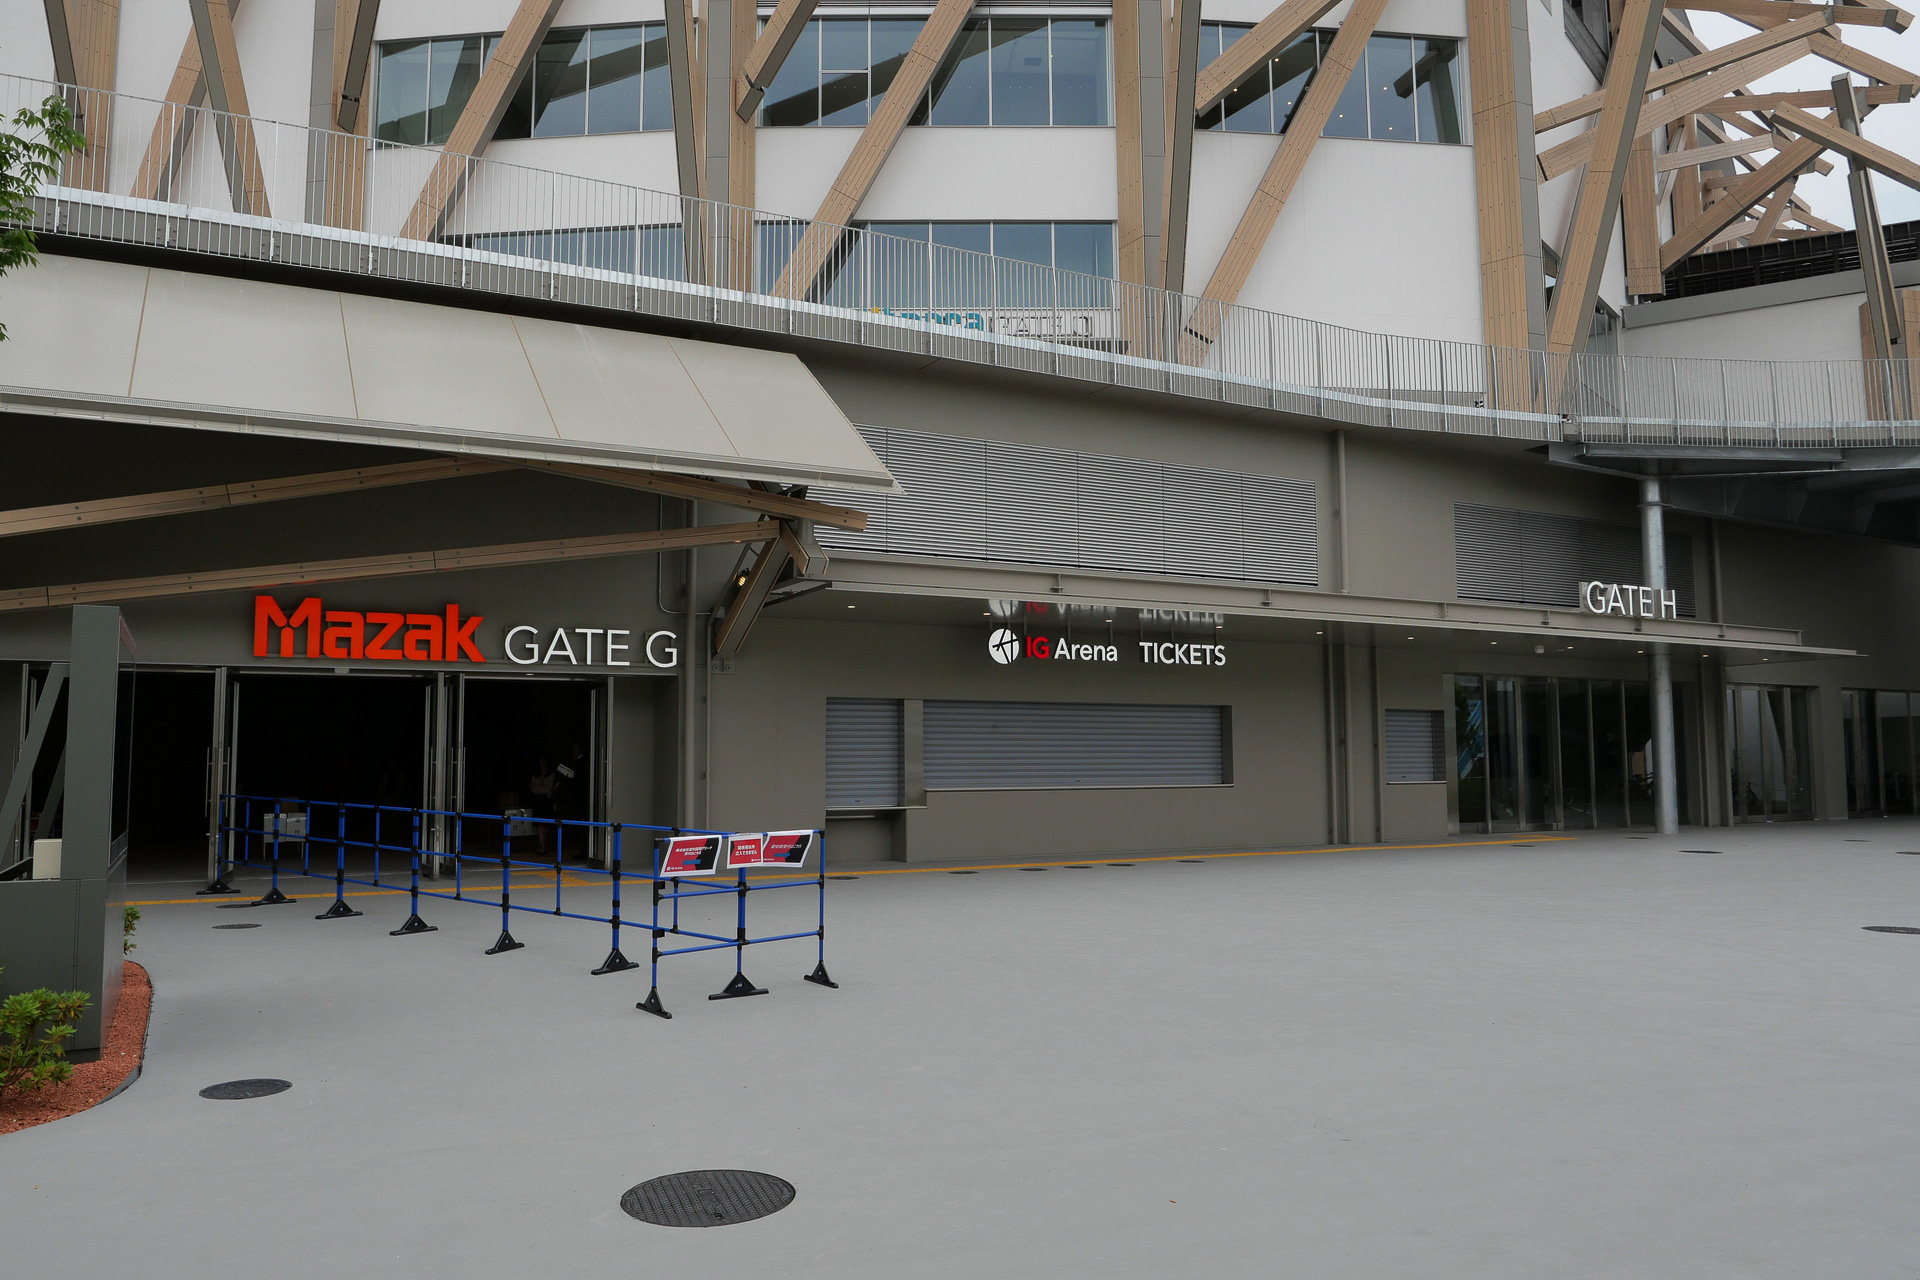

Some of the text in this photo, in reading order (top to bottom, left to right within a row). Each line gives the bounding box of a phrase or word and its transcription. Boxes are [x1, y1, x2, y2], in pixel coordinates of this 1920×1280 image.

[1586, 580, 1677, 619] GATE H
[253, 595, 678, 668] Mazak GATE G
[1026, 636, 1226, 667] IG Arena TICKETS
